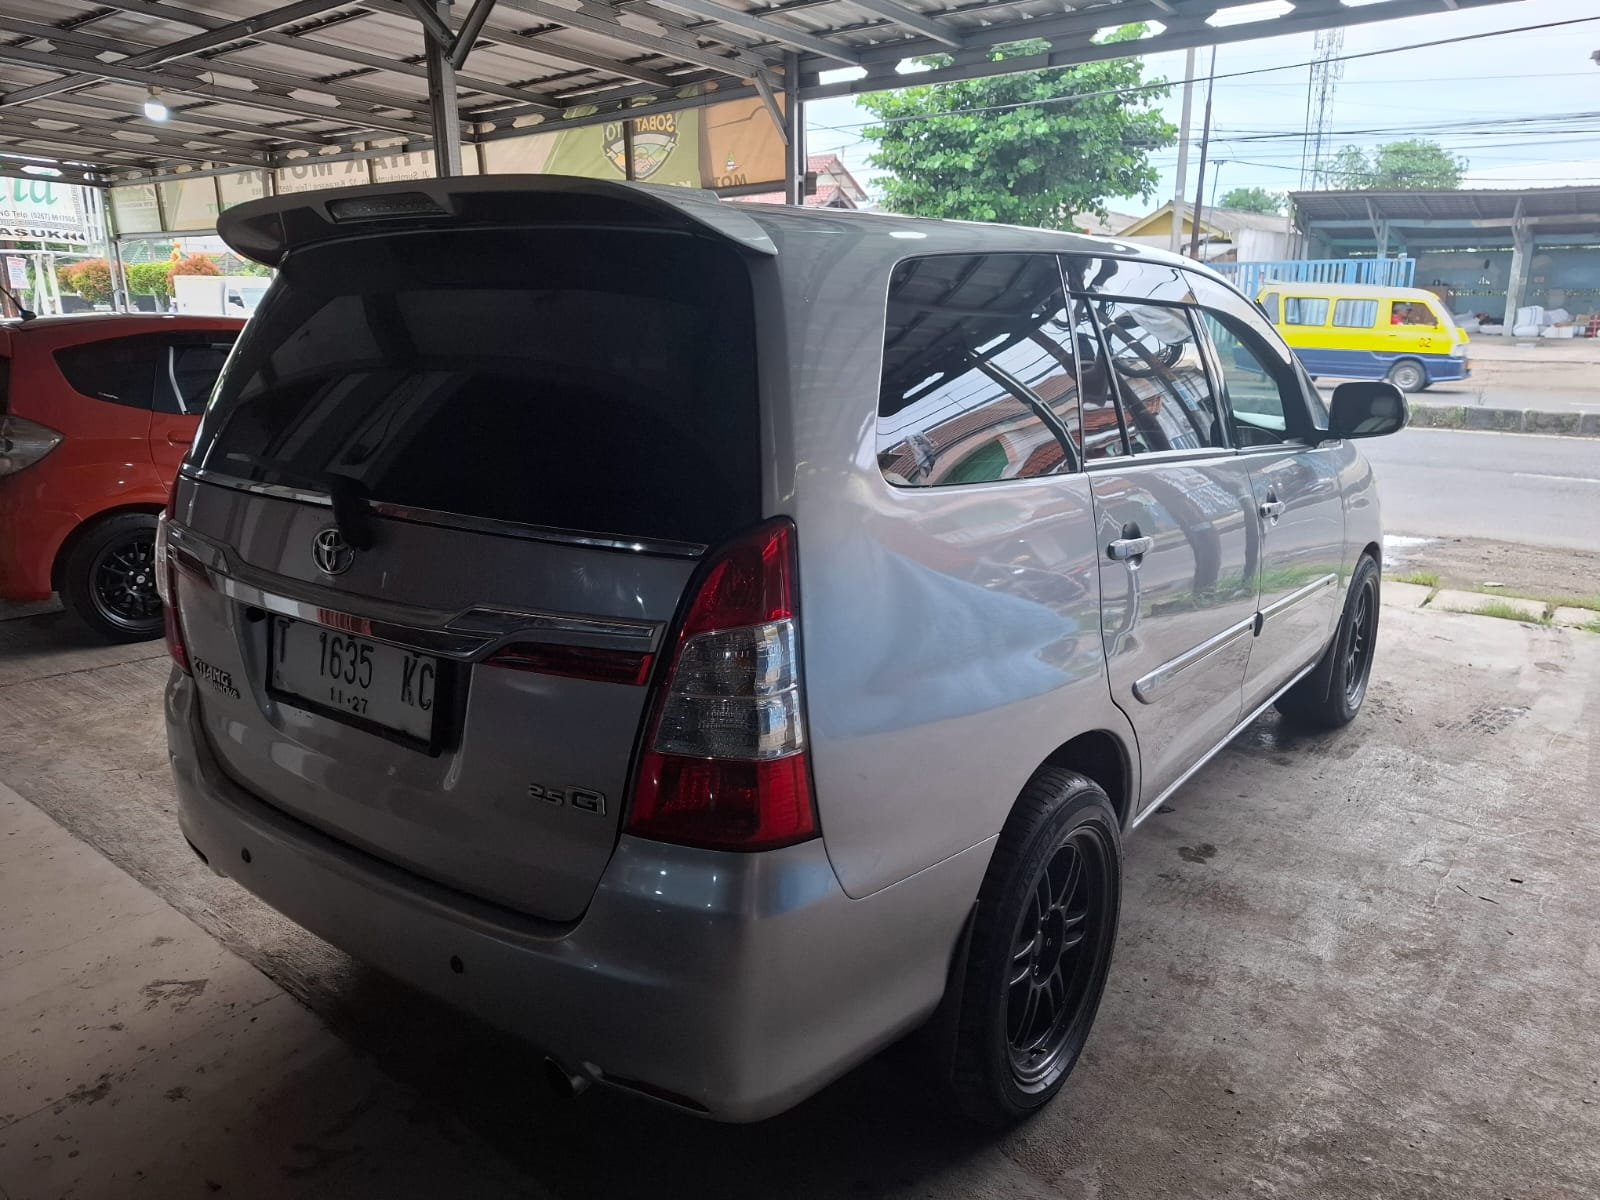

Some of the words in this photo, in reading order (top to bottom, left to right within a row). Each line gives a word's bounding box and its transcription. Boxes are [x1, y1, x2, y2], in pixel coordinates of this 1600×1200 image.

[278, 620, 290, 663] T
[319, 632, 374, 689] 1635
[401, 655, 434, 711] KC
